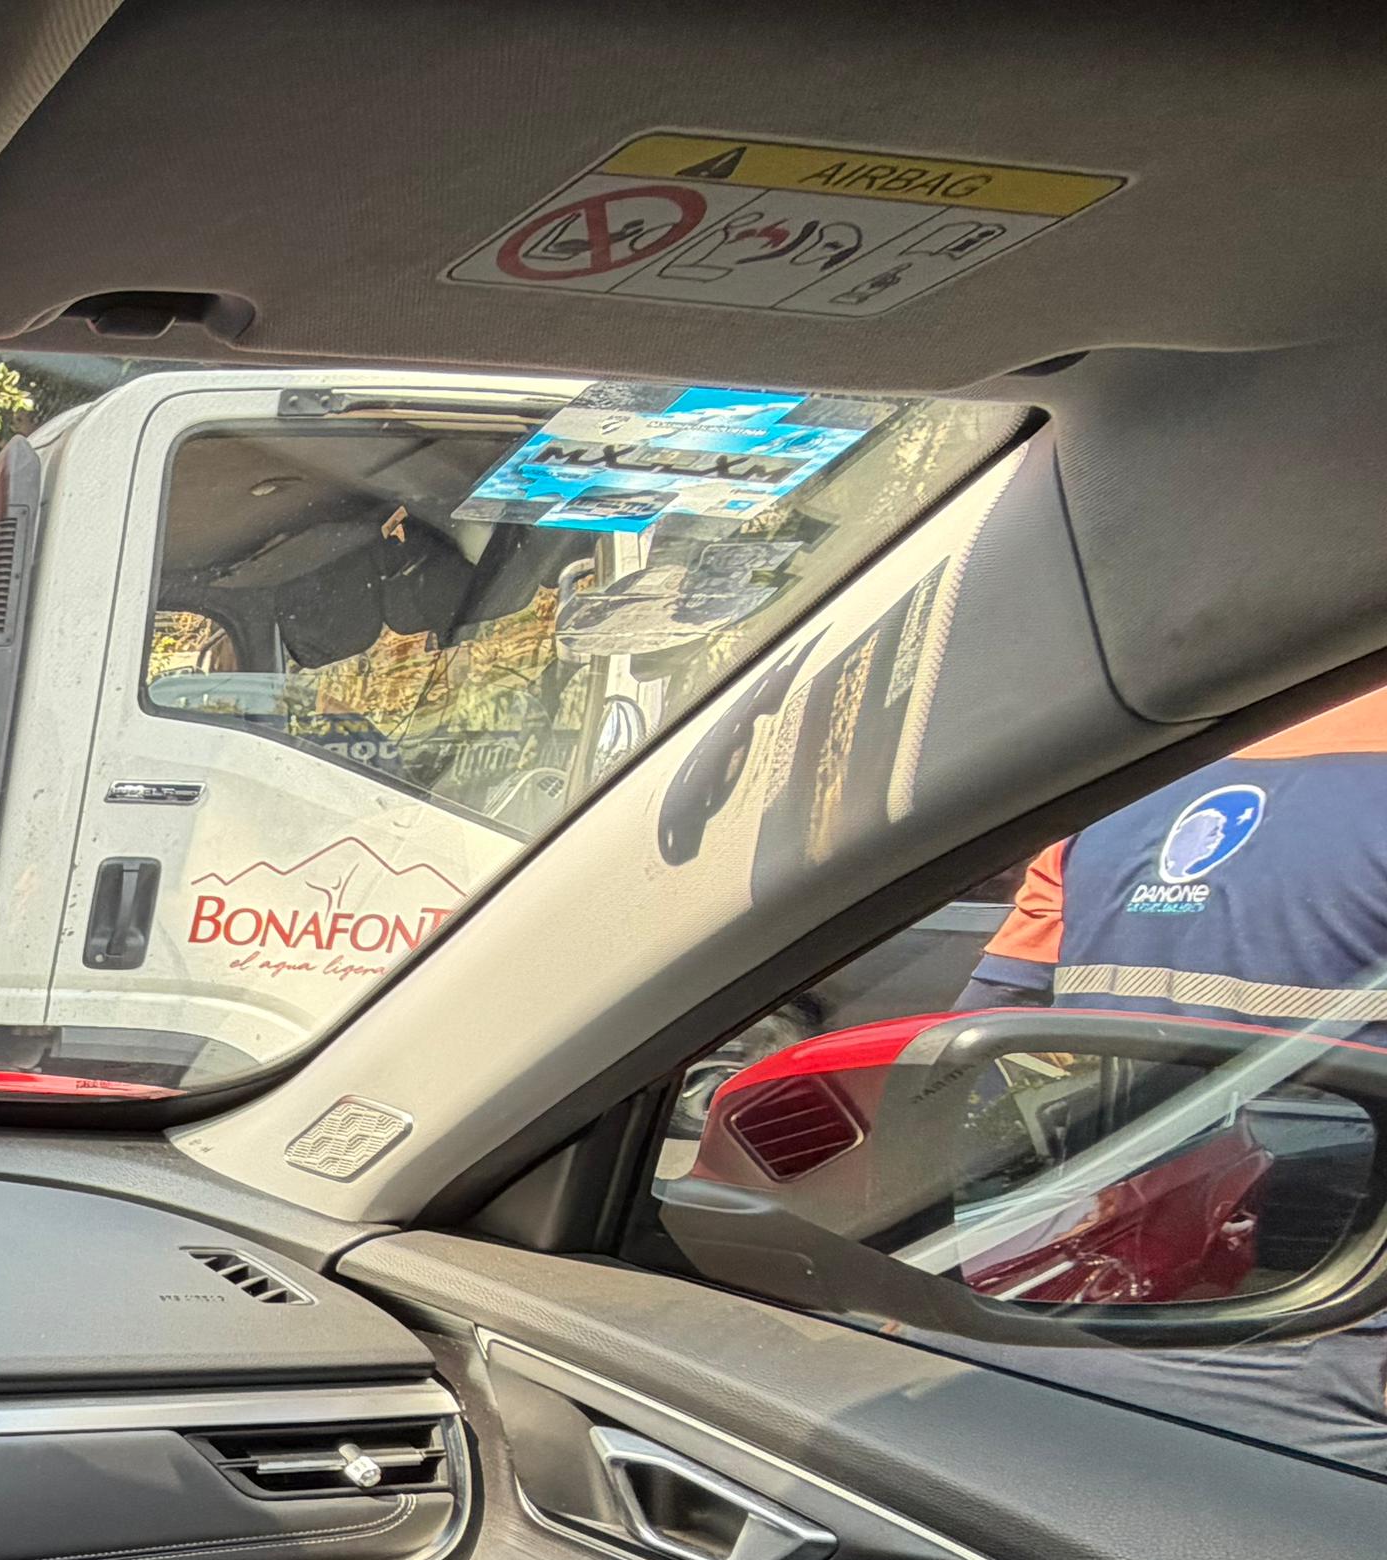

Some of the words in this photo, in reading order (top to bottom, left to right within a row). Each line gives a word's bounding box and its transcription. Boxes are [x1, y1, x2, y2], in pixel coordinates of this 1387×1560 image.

[798, 161, 993, 198] AIRBAG
[229, 951, 261, 971] el
[259, 959, 317, 978] agua
